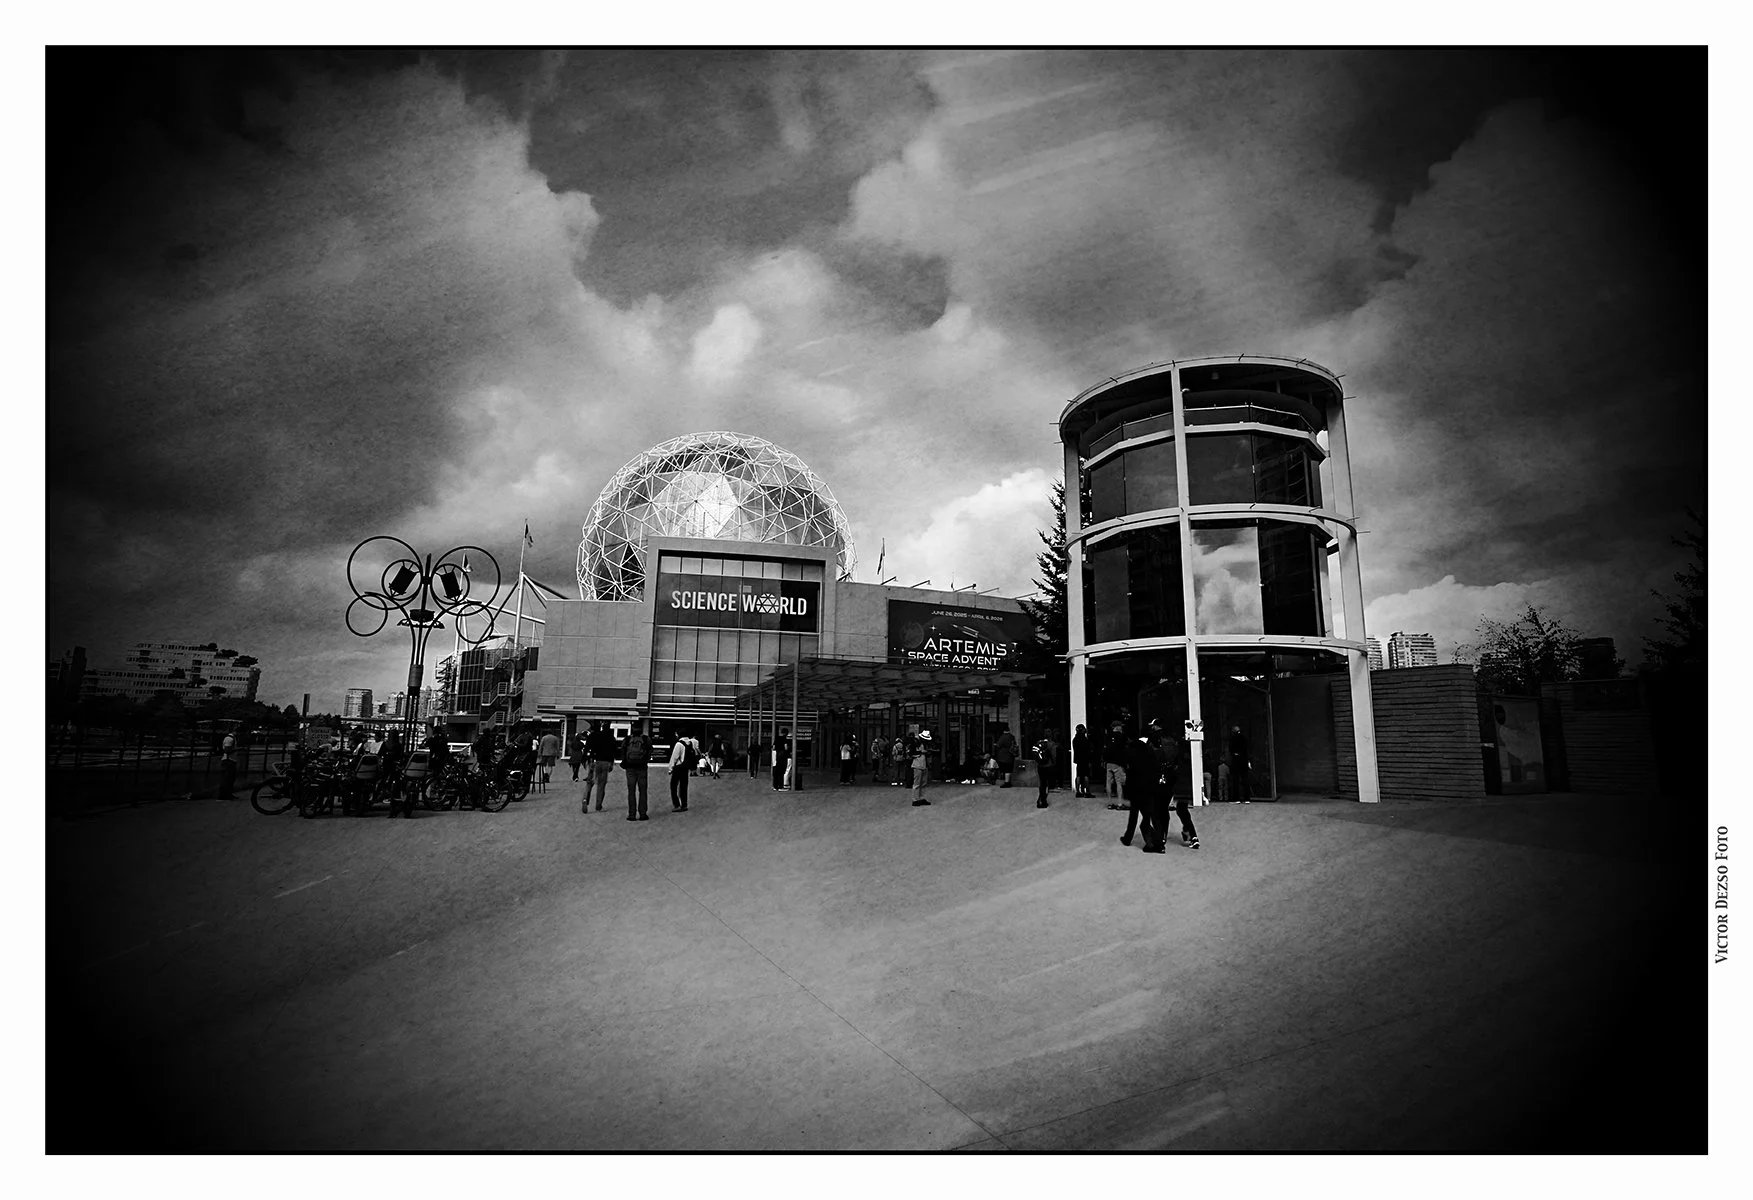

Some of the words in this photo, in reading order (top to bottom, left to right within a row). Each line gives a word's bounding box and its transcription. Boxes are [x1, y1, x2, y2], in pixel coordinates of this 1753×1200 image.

[671, 590, 738, 612] SCIENCE
[923, 637, 1007, 656] ARTEMIS
[907, 651, 949, 663] SPACE
[951, 655, 1001, 666] ADVENT
